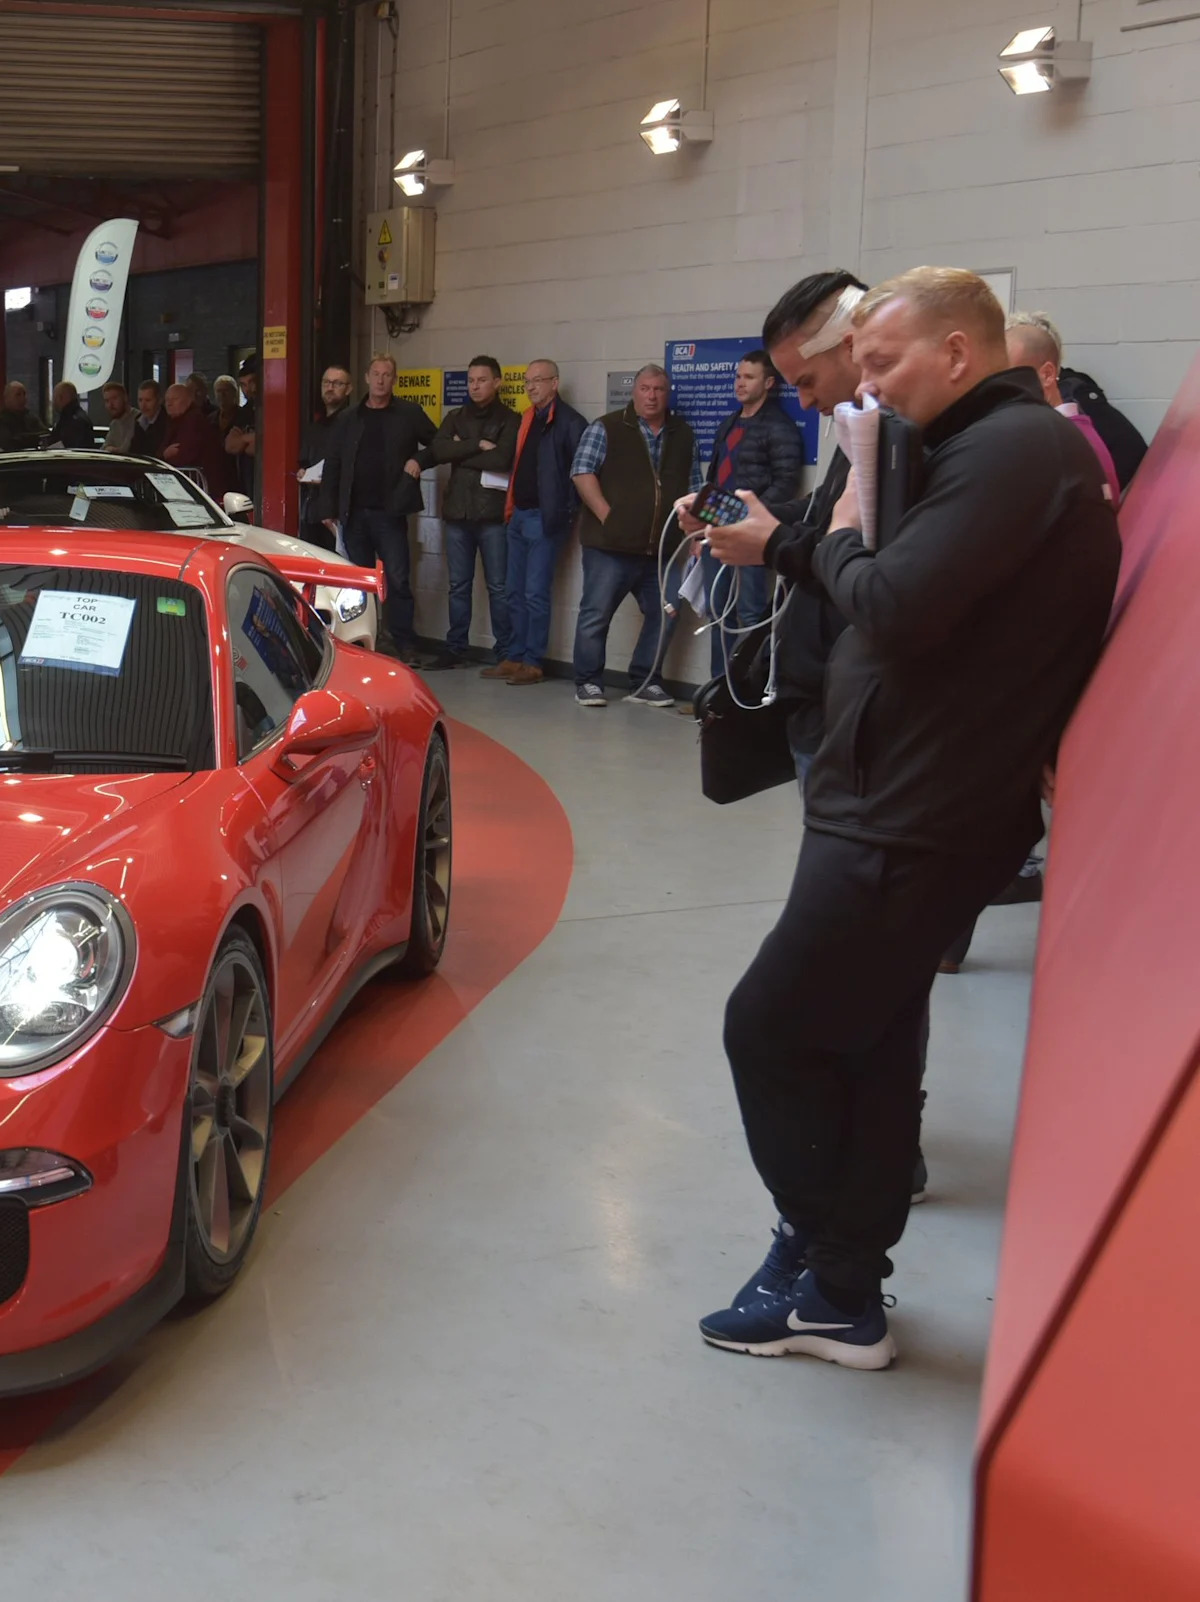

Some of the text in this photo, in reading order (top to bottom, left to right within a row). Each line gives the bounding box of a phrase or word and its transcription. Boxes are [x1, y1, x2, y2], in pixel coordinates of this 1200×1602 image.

[672, 364, 694, 372] HEALTH
[695, 363, 710, 372] AND
[710, 362, 734, 371] SAFETY
[399, 375, 430, 388] BEWARE
[500, 384, 525, 395] HICLES
[397, 394, 436, 406] TOMATIC
[60, 612, 106, 624] TC002
